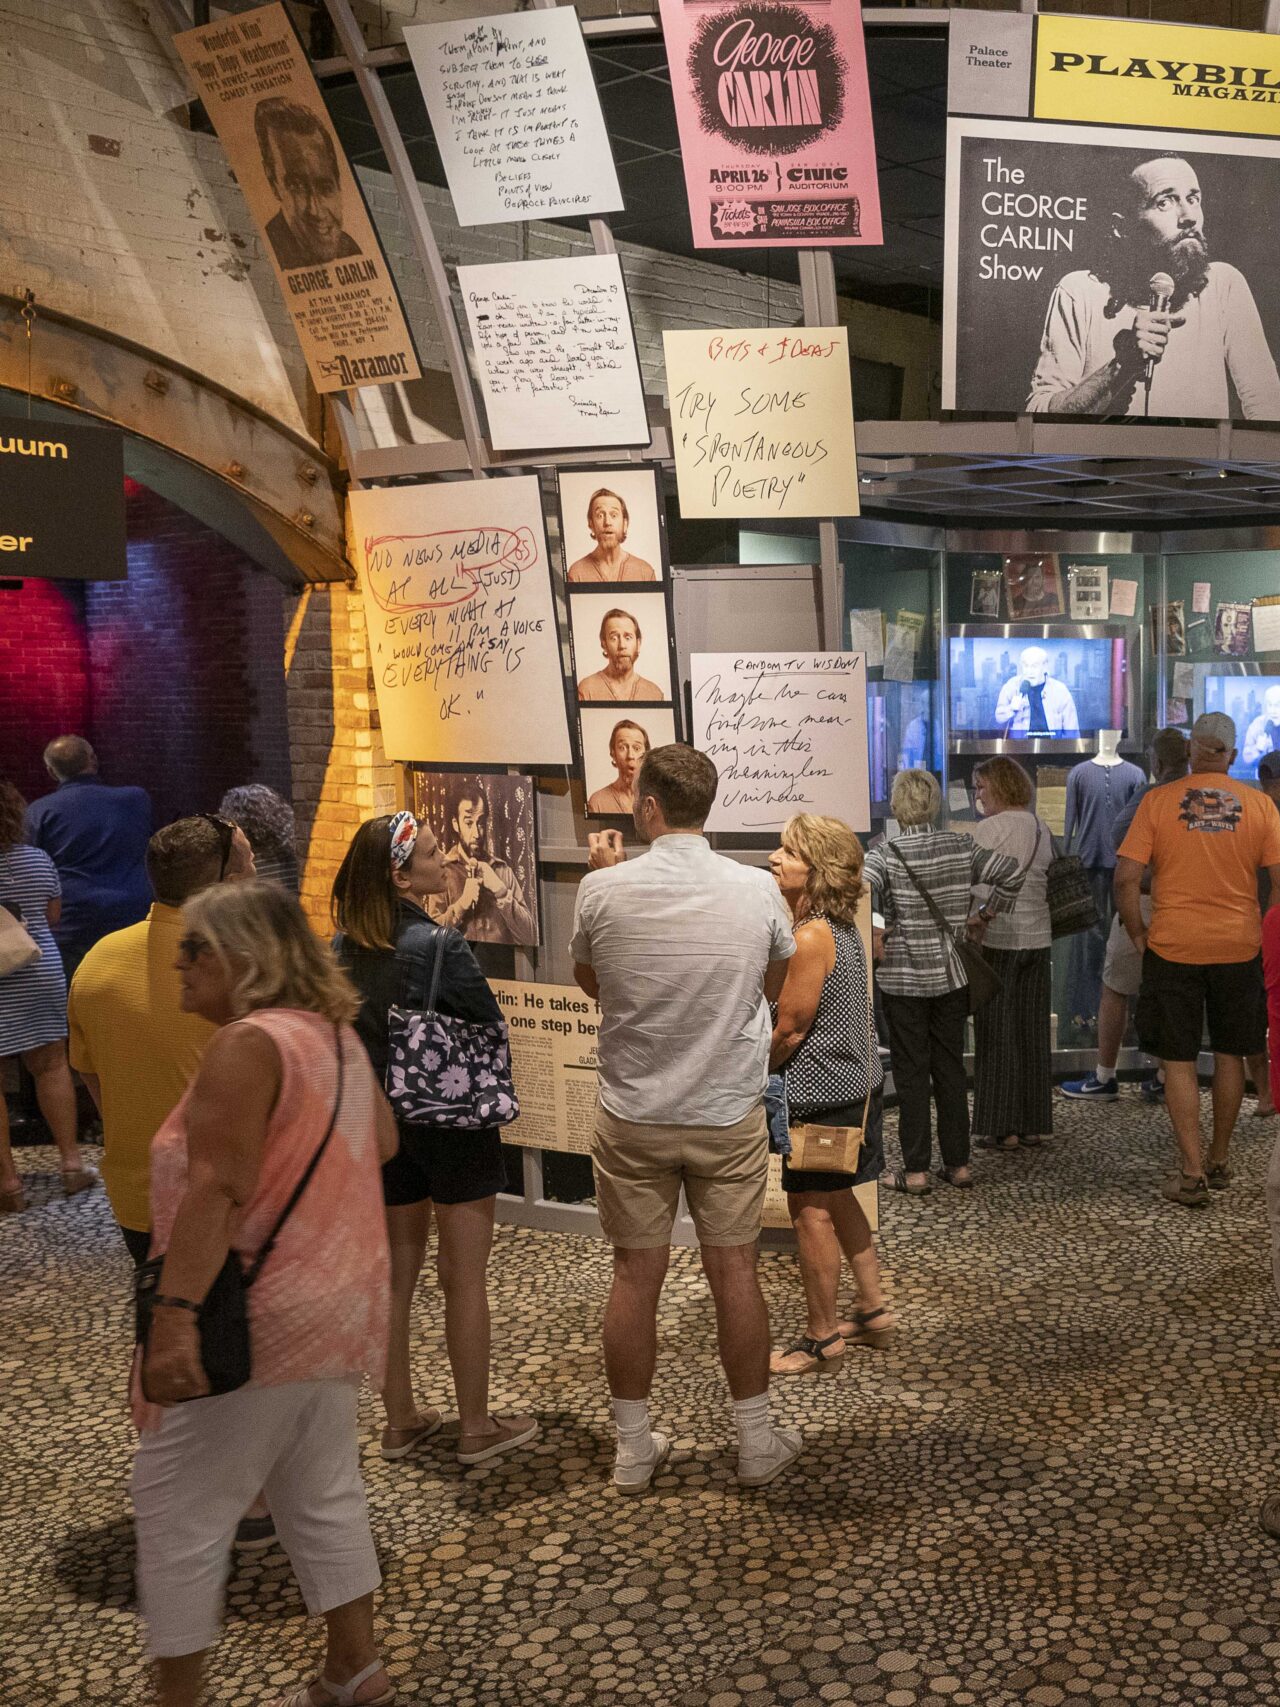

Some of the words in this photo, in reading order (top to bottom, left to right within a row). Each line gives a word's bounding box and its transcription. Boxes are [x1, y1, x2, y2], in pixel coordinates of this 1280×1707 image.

[713, 18, 816, 82] George
[968, 45, 1009, 57] Palace
[965, 55, 1013, 69] Theater
[250, 73, 293, 94] SENSATION
[718, 69, 822, 128] CARLIN
[709, 169, 749, 184] APRIL
[787, 167, 849, 182] CIVIC
[983, 157, 1025, 185] The
[715, 184, 745, 193] 8:00
[747, 184, 763, 192] PM
[788, 182, 849, 190] AUDITORIUM
[720, 203, 751, 222] Tickets
[820, 203, 848, 212] OFFICE
[981, 191, 1088, 221] GEORGE
[821, 217, 846, 226] OFFICE
[980, 223, 1074, 252] CARLIN
[287, 269, 333, 295] GEORGE
[335, 259, 378, 286] CARLIN
[978, 255, 1043, 281] Show
[335, 288, 371, 303] MARAMOR
[676, 382, 717, 432] TRY
[734, 387, 810, 416] SOME
[403, 544, 443, 567] NEWS
[450, 530, 501, 561] MEDIA
[385, 609, 437, 641] EVERY
[501, 621, 509, 635] A
[513, 619, 546, 634] VOICE
[393, 644, 421, 660] WOULD
[425, 644, 451, 657] COME
[488, 637, 509, 652] SAY
[383, 648, 494, 690] EVERYTHING
[506, 647, 525, 672] IS
[734, 659, 780, 672] RANDOM
[785, 660, 806, 672] TV
[813, 656, 859, 671] WISDOM
[524, 993, 544, 1009] He
[549, 997, 589, 1014] takes
[511, 1016, 536, 1029] one
[541, 1019, 572, 1035] step
